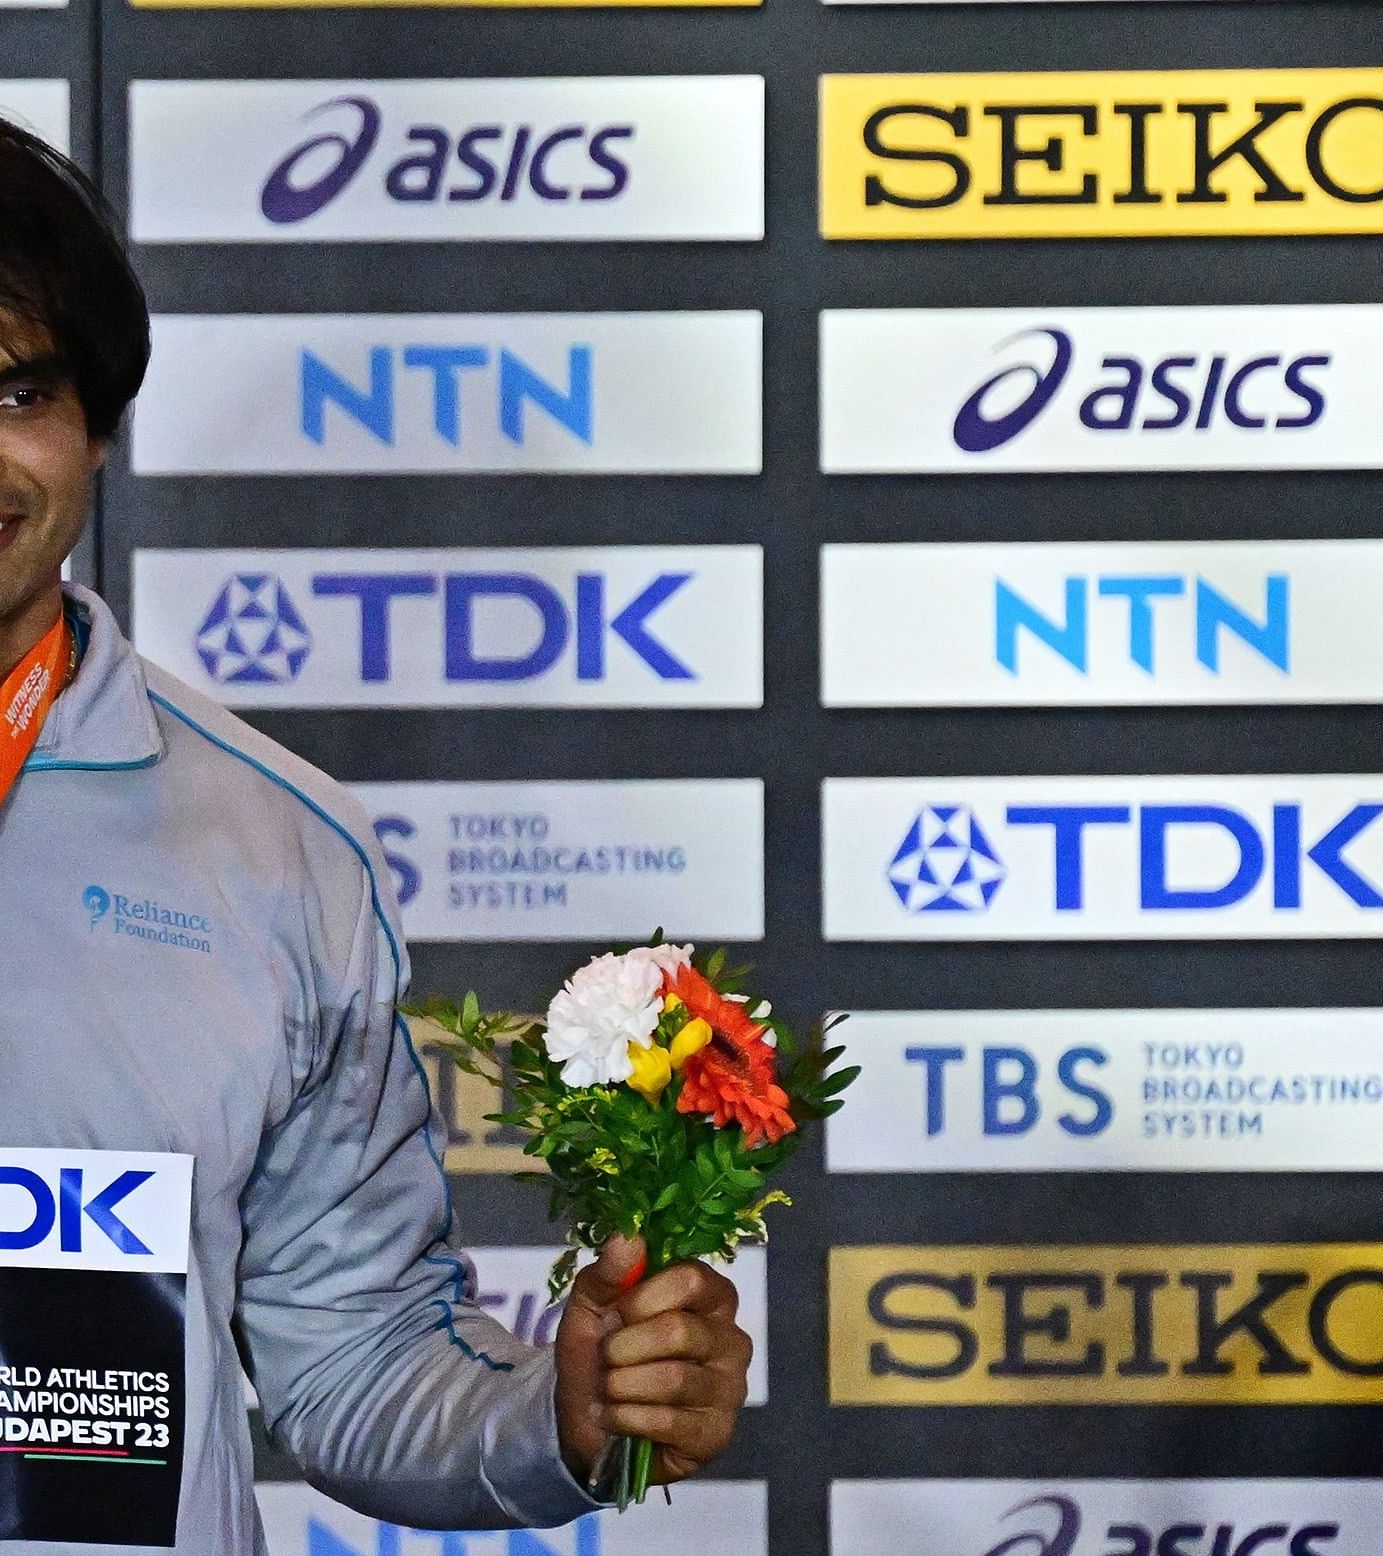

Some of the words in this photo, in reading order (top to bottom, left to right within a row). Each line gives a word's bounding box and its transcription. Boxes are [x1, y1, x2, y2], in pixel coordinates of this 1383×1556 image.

[386, 122, 635, 204] asics
[863, 96, 1383, 210] SEIKO
[300, 345, 593, 447] NTN
[1079, 355, 1331, 430] asics
[311, 572, 696, 684] TDK
[996, 574, 1290, 675] NTN
[5, 662, 43, 724] WITNESS
[16, 669, 51, 731] WONDER
[448, 814, 550, 841] TOKYO
[1005, 803, 1383, 911] TDK
[447, 845, 686, 875] BROADCASTING
[447, 881, 568, 908] SYSTEM
[112, 917, 212, 953] Foundation
[1142, 1042, 1244, 1070] TOKYO
[905, 1046, 1114, 1138] TBS
[1141, 1076, 1383, 1105] BROADCASTING
[1141, 1112, 1263, 1138] SYSTEM
[867, 1268, 1383, 1379] SEIKO
[46, 1368, 170, 1393] ATHLETICS
[134, 1422, 170, 1448] 23
